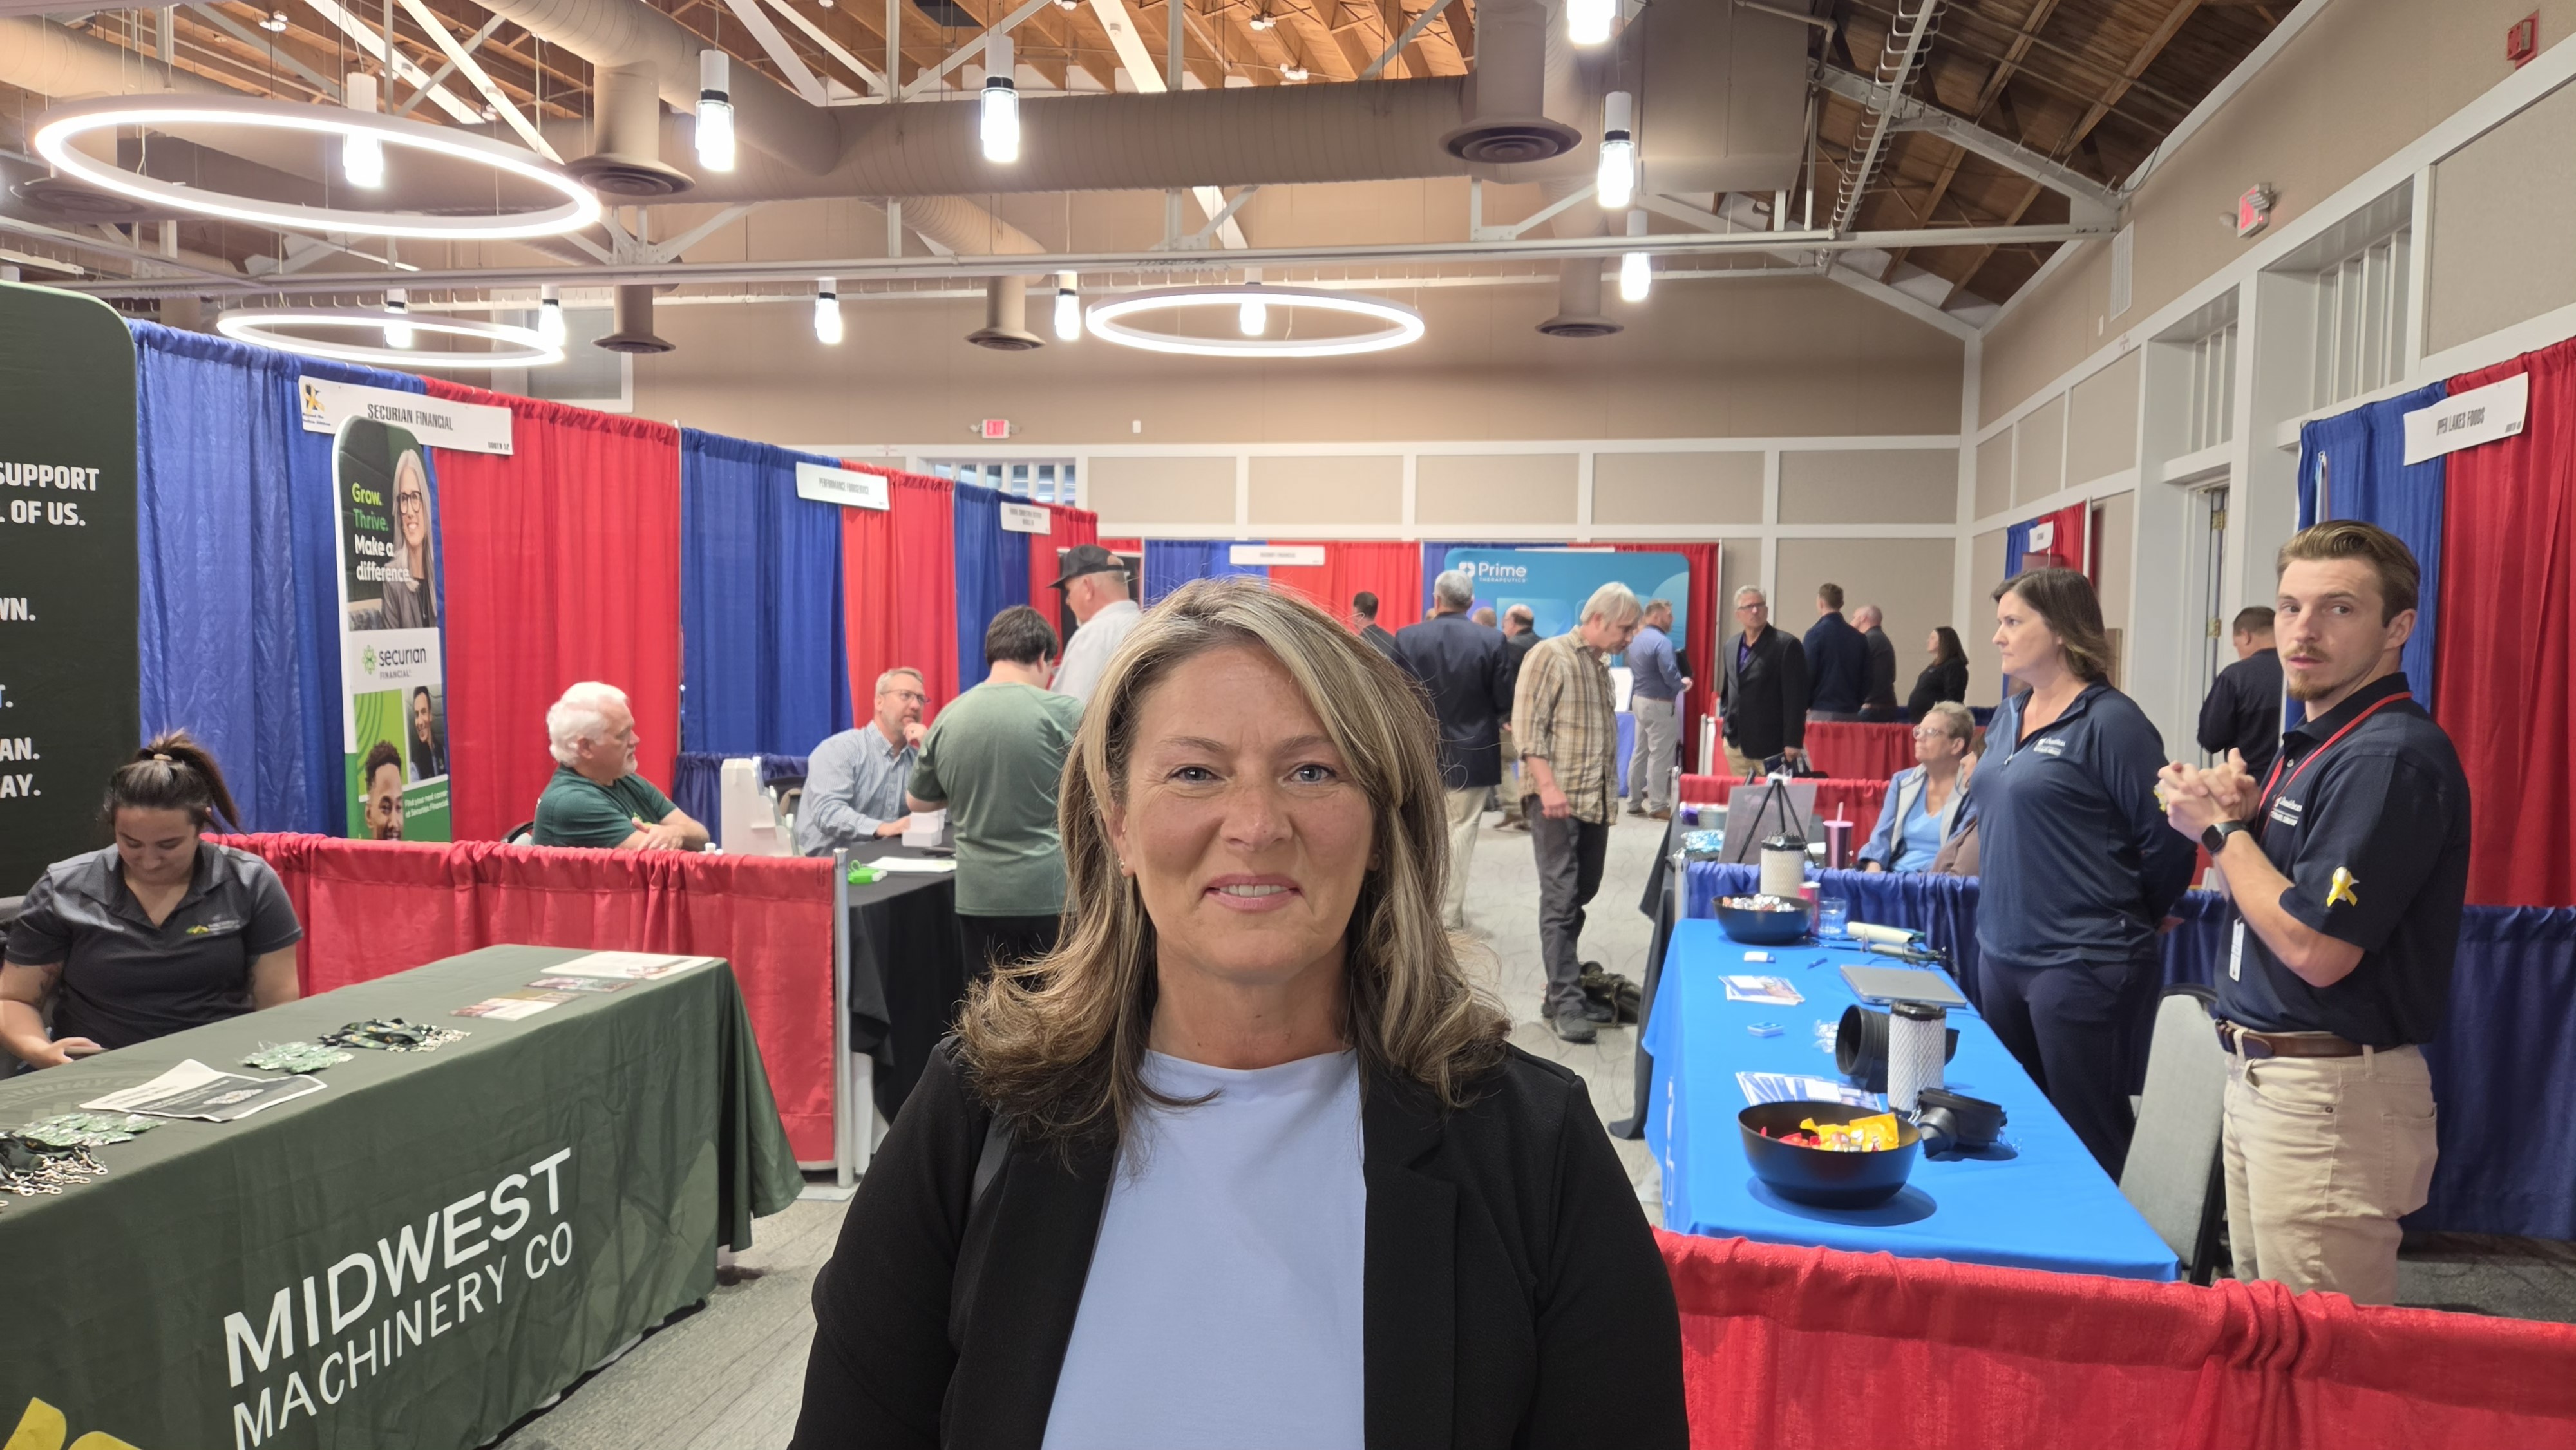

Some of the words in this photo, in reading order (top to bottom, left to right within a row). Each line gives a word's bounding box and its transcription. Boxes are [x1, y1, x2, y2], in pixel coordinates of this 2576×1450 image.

[367, 403, 413, 424] SECURIAN
[415, 410, 453, 431] FINANCIAL
[2448, 411, 2466, 431] LAKES
[2467, 406, 2485, 428] FOODS
[352, 482, 383, 505] Grow.
[10, 499, 42, 524] OF
[47, 501, 86, 527] US.
[353, 508, 390, 531] Thrive.
[354, 534, 386, 557] Make
[386, 542, 395, 558] a
[356, 561, 411, 582] difference.
[1478, 561, 1527, 577] Prime
[378, 648, 427, 667] securian
[379, 670, 410, 679] FINANCIAL
[224, 1147, 571, 1388] MIDWEST
[233, 1255, 507, 1450] MACHINERY
[525, 1221, 573, 1279] CO
